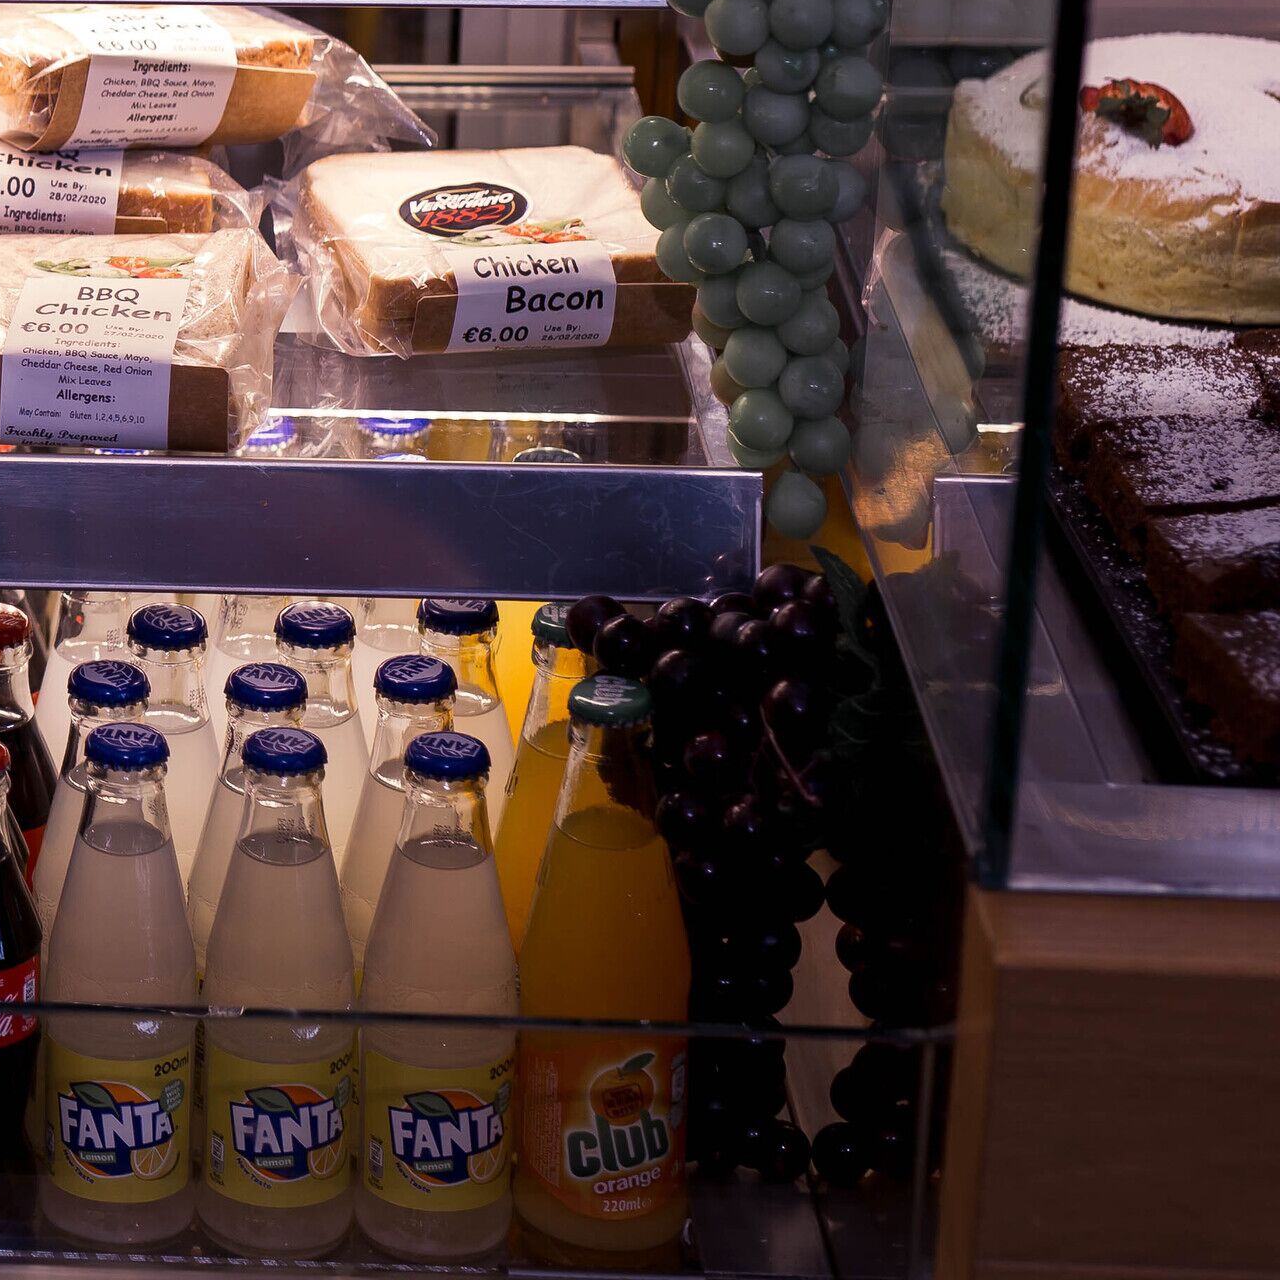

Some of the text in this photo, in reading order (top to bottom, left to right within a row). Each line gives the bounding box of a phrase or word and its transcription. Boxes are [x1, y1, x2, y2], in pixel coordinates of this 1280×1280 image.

[133, 60, 191, 73] Ingredients:
[49, 192, 106, 205] 28/02/2020
[4, 205, 66, 222] Ingredients:
[419, 205, 506, 227] 1882
[473, 254, 579, 278] Chicken
[77, 287, 140, 304] BBQ
[505, 286, 604, 314] Bacon
[35, 303, 172, 321] Chicken
[21, 322, 89, 335] €6.00
[462, 326, 529, 343] €6.00
[55, 337, 121, 348] Ingredients:
[21, 358, 152, 376] Cheddar Cheese, Red Onion
[58, 375, 112, 387] Mix Leaves
[56, 389, 116, 404] Allergens:
[239, 669, 298, 686] FANTA
[96, 724, 158, 746] FANTA
[419, 734, 482, 758] FANTA
[60, 1097, 172, 1149] FANTA
[231, 1105, 344, 1153] FANTA
[391, 1106, 504, 1158] FANTA
[593, 1167, 661, 1194] orange
